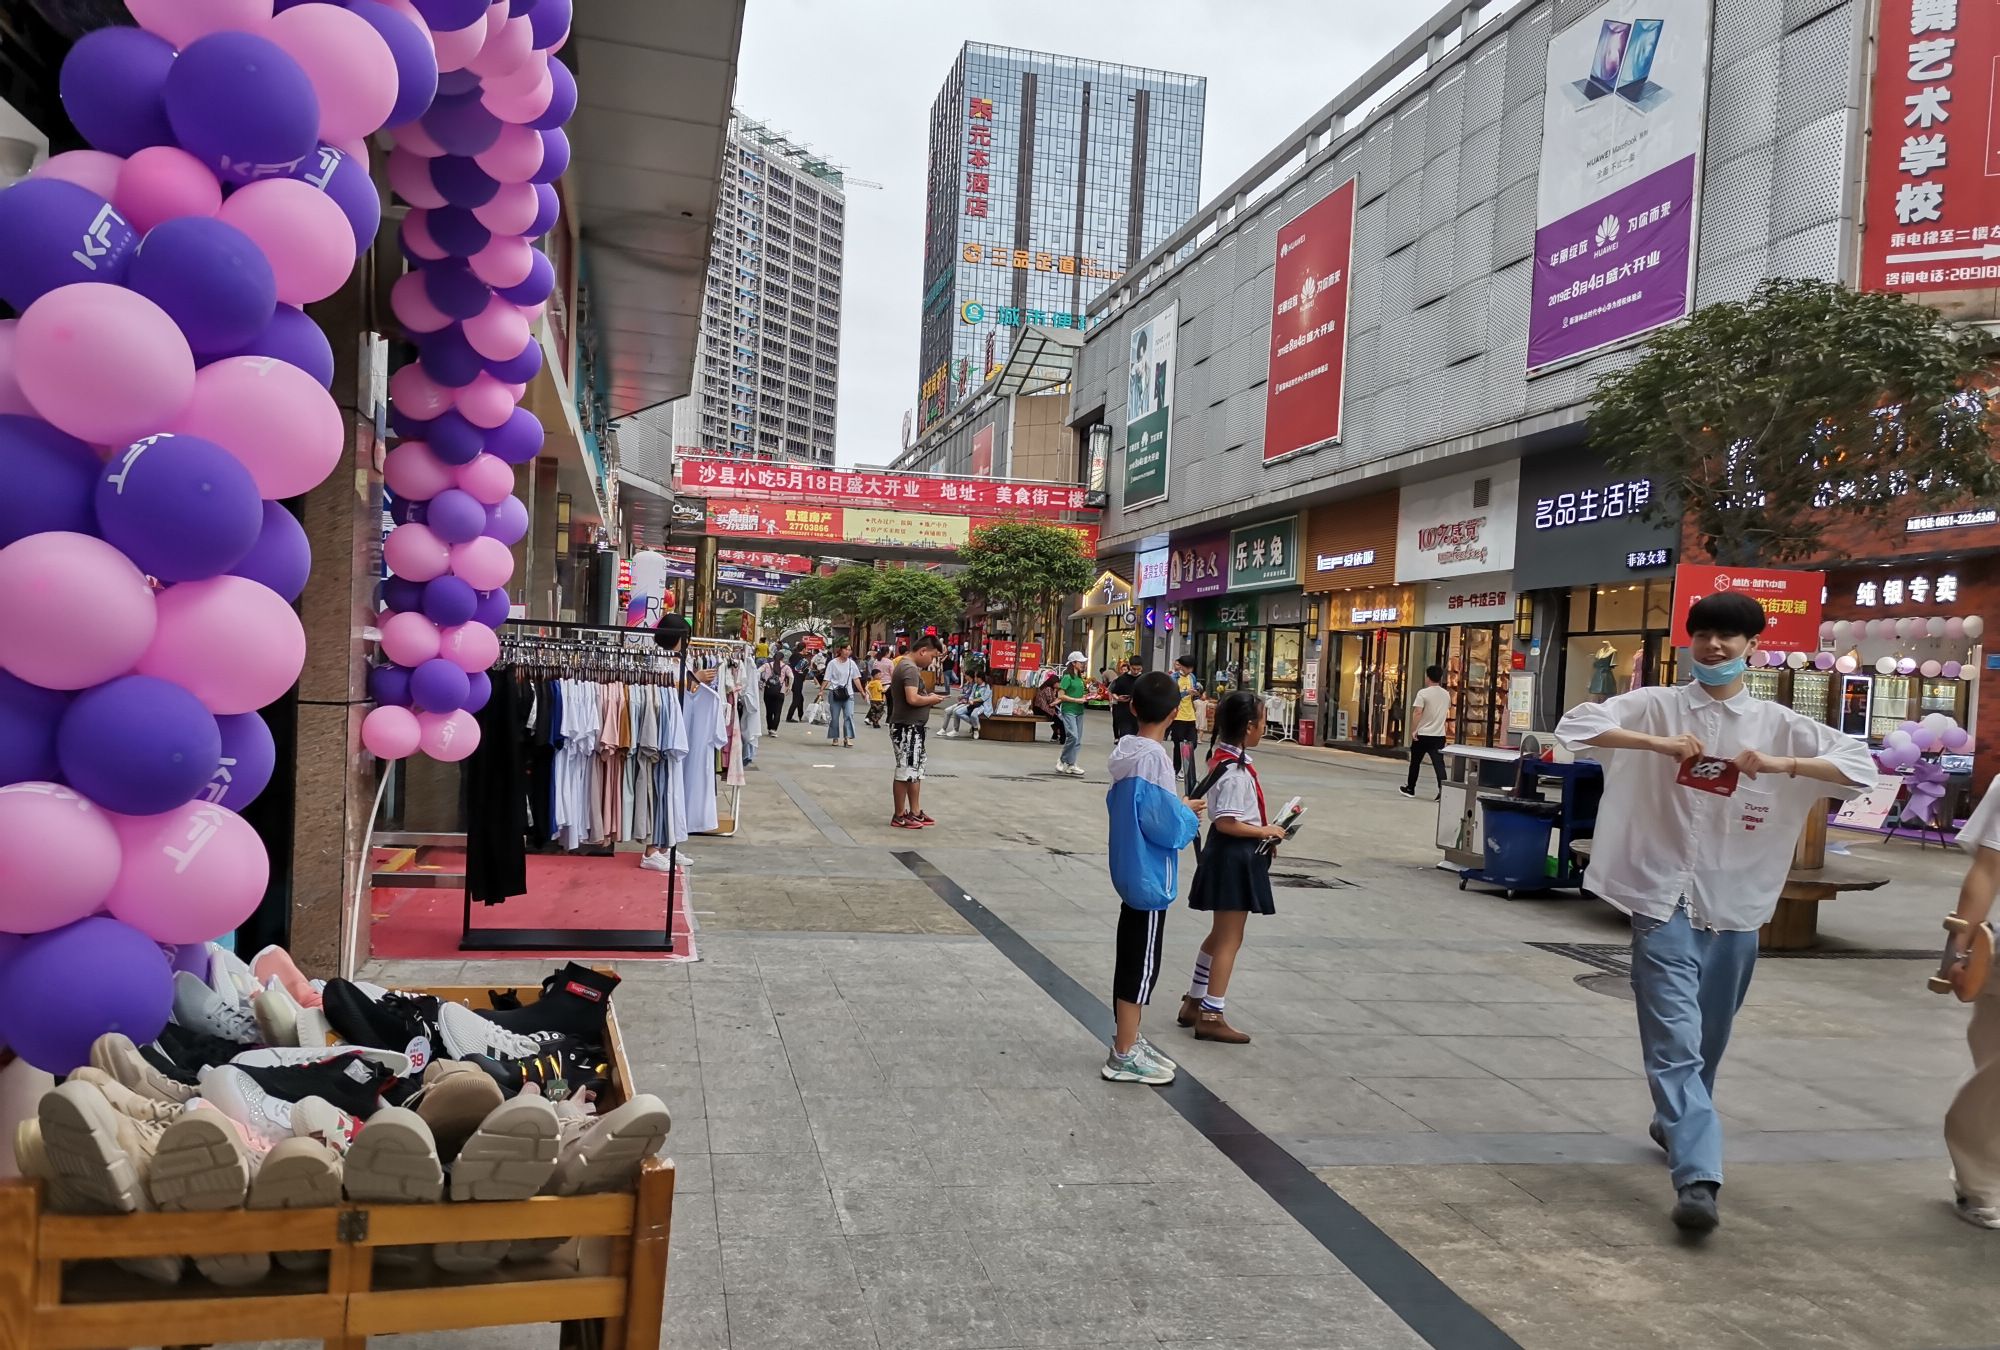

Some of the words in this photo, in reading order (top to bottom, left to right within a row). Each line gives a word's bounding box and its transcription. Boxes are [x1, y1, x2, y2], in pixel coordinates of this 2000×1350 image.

[1627, 200, 1671, 233] 为你而来
[72, 203, 126, 271] KFT
[1550, 240, 1588, 267] 华丽绽放
[1593, 242, 1619, 259] HUAWEI
[698, 465, 920, 498] 沙县小吃5月18日盛大开业
[1535, 479, 1650, 529] 名品生活馆
[1235, 535, 1283, 572] 乐米兔
[1855, 574, 1958, 606] 纯银专卖
[163, 803, 233, 875] KFT
